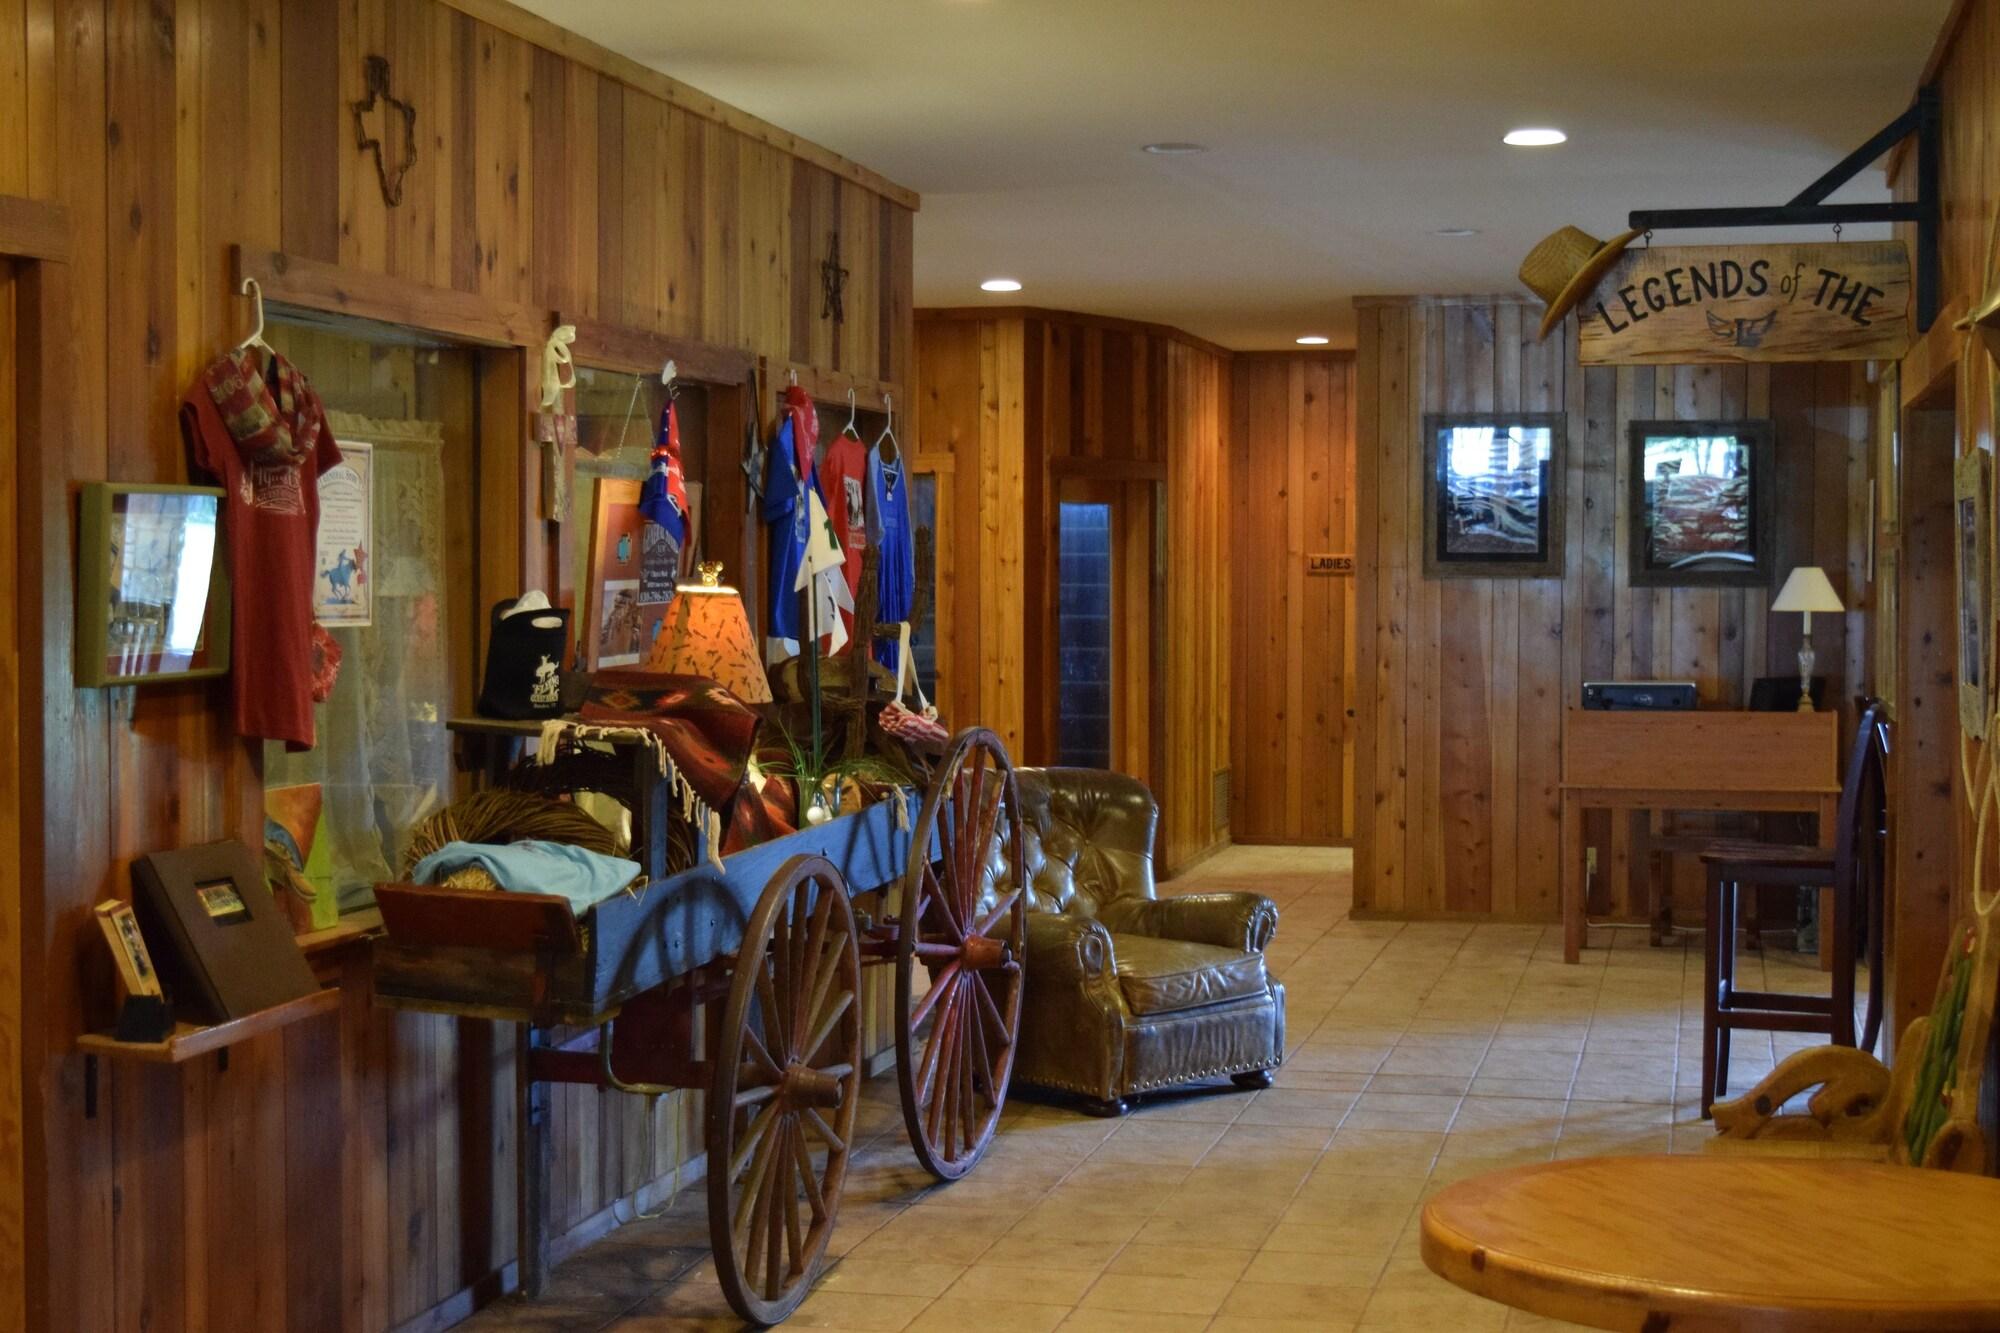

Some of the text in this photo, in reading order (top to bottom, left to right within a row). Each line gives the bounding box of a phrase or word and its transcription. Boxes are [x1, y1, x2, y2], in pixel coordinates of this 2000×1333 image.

[1596, 259, 1885, 334] LEGENDS of THE
[1311, 558, 1351, 569] LADIES
